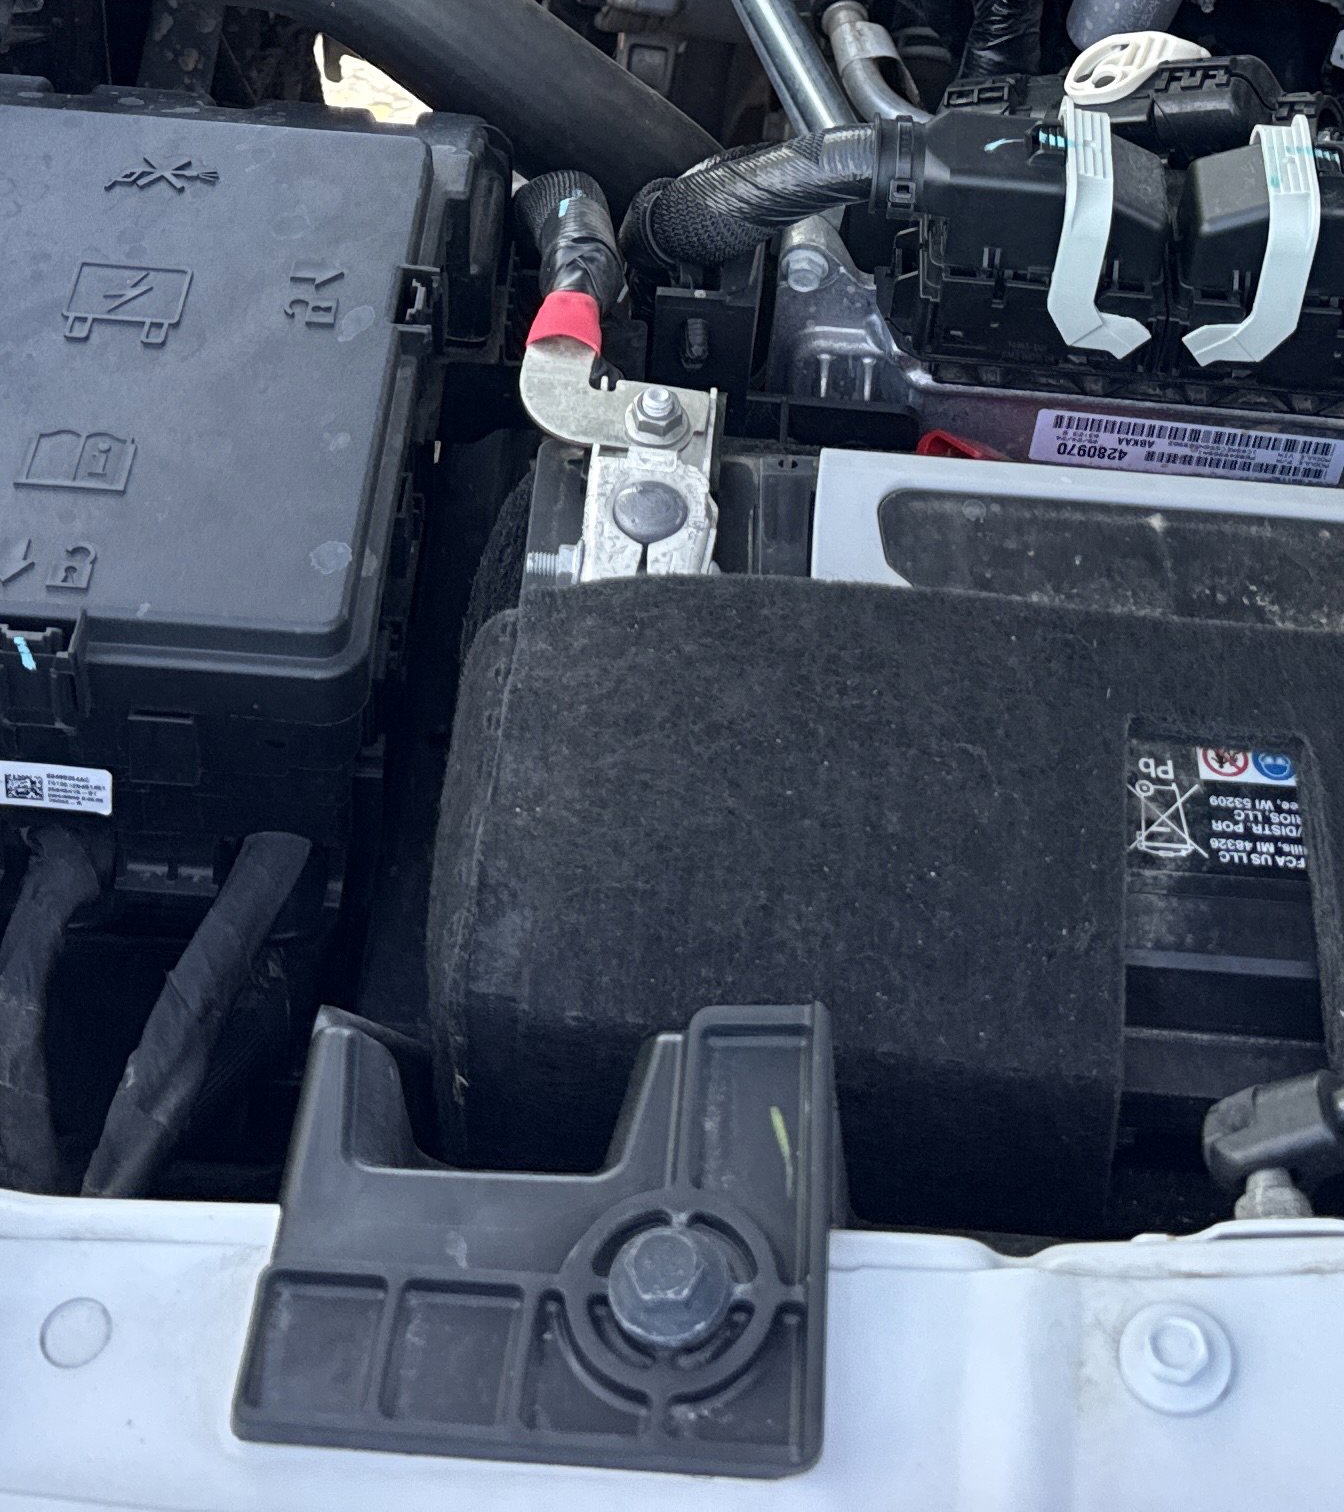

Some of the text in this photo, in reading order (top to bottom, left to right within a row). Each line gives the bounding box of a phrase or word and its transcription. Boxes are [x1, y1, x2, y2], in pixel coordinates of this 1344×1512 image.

[1117, 436, 1155, 449] ABKAA
[1056, 442, 1128, 462] 4280970
[1138, 757, 1175, 779] Pb
[1209, 794, 1252, 808] 53209
[1255, 798, 1274, 811] WI
[1233, 809, 1262, 822] LLC
[1211, 819, 1244, 833] POR
[1209, 837, 1253, 851] 48326
[1256, 841, 1275, 853] MI
[1218, 850, 1306, 868] FCA US LLC
